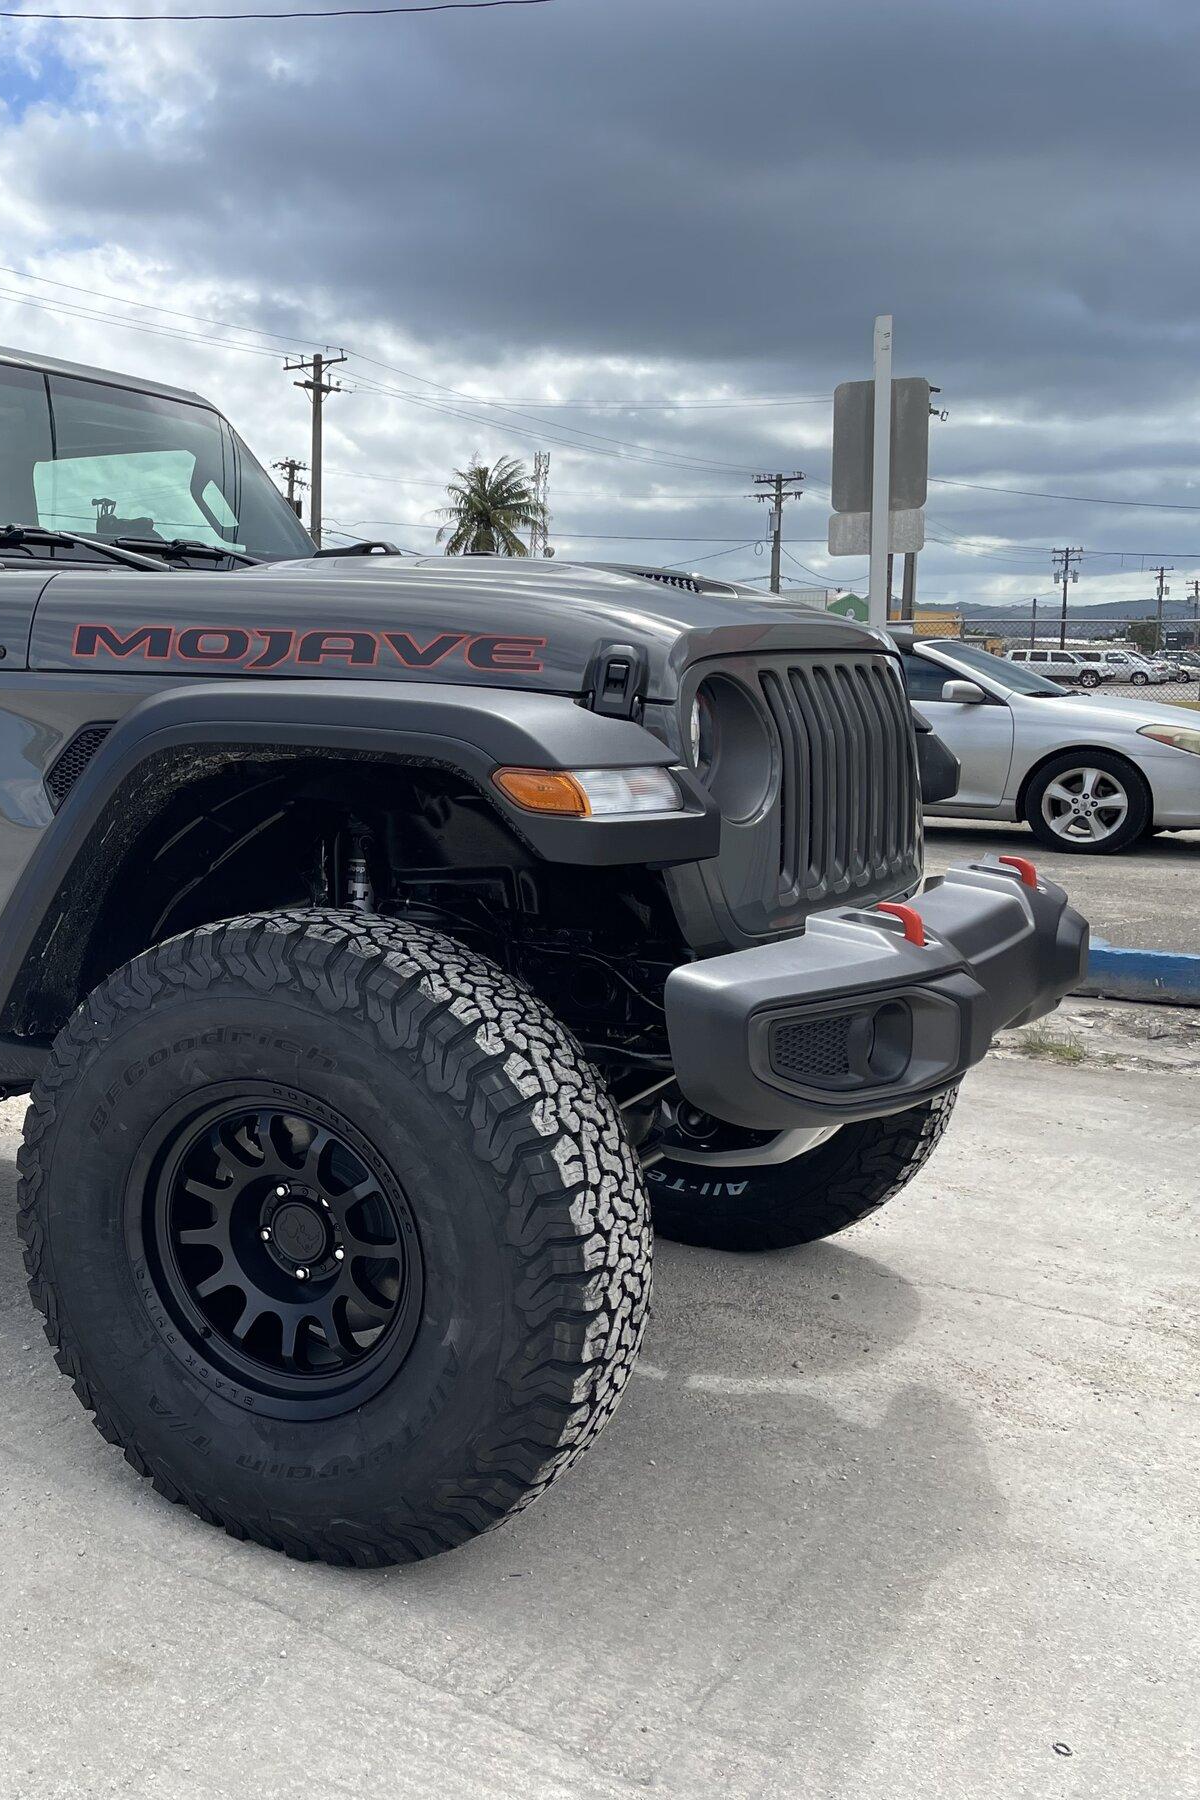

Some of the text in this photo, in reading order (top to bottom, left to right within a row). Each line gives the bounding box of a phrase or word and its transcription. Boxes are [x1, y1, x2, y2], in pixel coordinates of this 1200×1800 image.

[72, 623, 546, 672] MOJAVE
[88, 1025, 338, 1137] BFGoodrich
[271, 1086, 414, 1236] ROTARY FORGED
[646, 1169, 749, 1196] All-Te
[135, 1266, 255, 1407] BLACK RHINO
